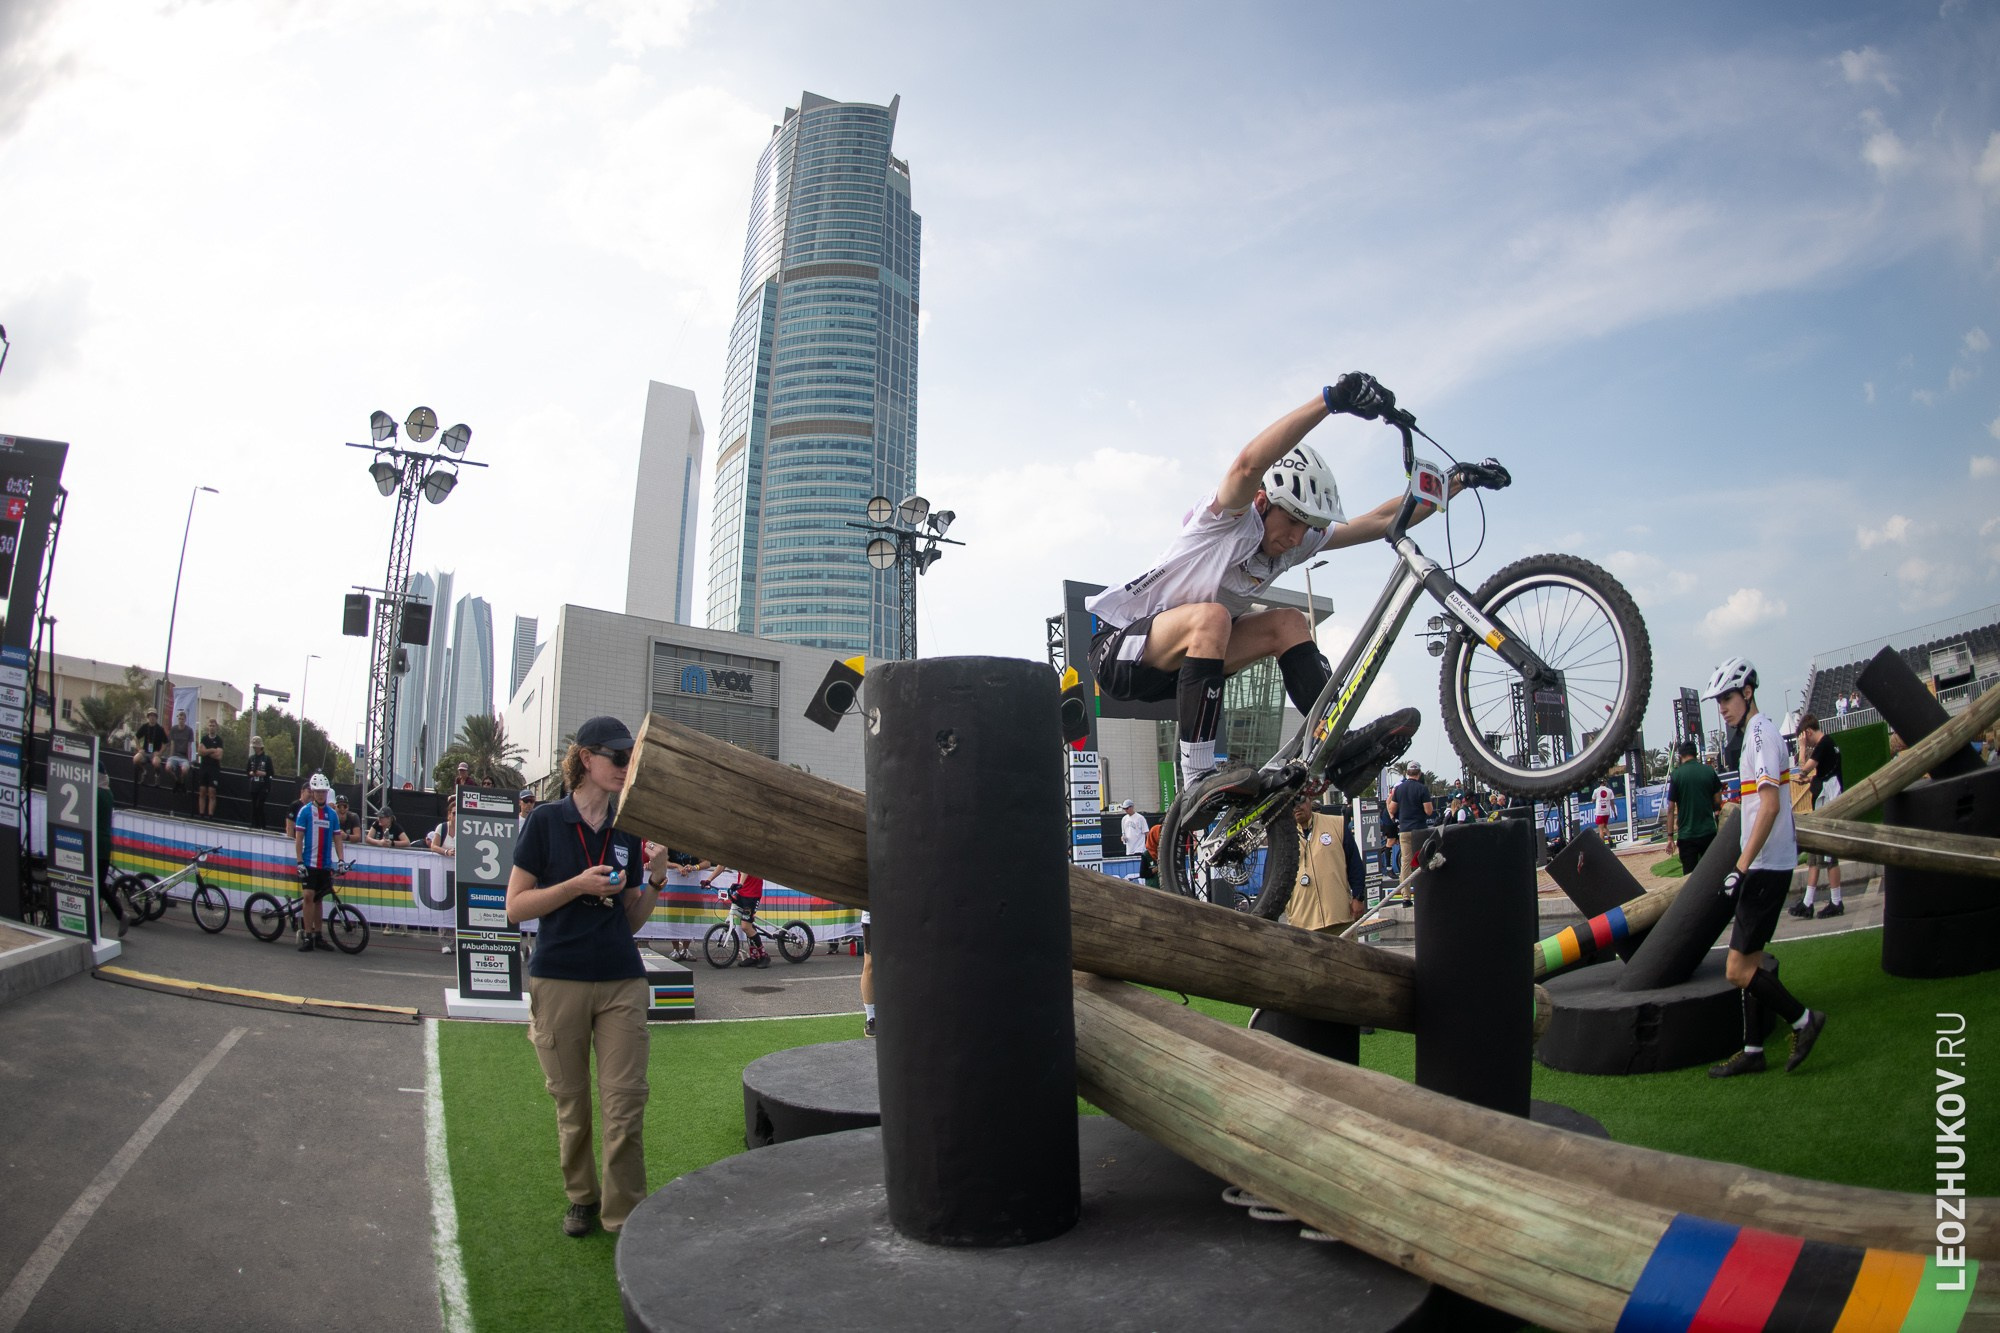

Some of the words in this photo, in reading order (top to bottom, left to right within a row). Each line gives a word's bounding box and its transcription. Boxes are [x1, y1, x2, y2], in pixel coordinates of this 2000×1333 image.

[1449, 594, 1466, 610] ADAC
[1465, 607, 1480, 623] Team
[1491, 629, 1504, 641] ADAC
[710, 669, 753, 693] VOX
[1078, 753, 1096, 763] UCI
[49, 762, 91, 783] FINISH
[60, 783, 80, 824] 2
[1362, 815, 1379, 825] START
[462, 820, 514, 838] START
[1366, 825, 1377, 848] 4
[1615, 834, 1628, 842] UC
[473, 839, 500, 880] 3
[65, 873, 76, 881] UCI
[470, 893, 505, 902] SHIMANO
[61, 900, 82, 910] TISSOT
[481, 932, 496, 940] UCI
[462, 943, 517, 952] #Abudhabi2024
